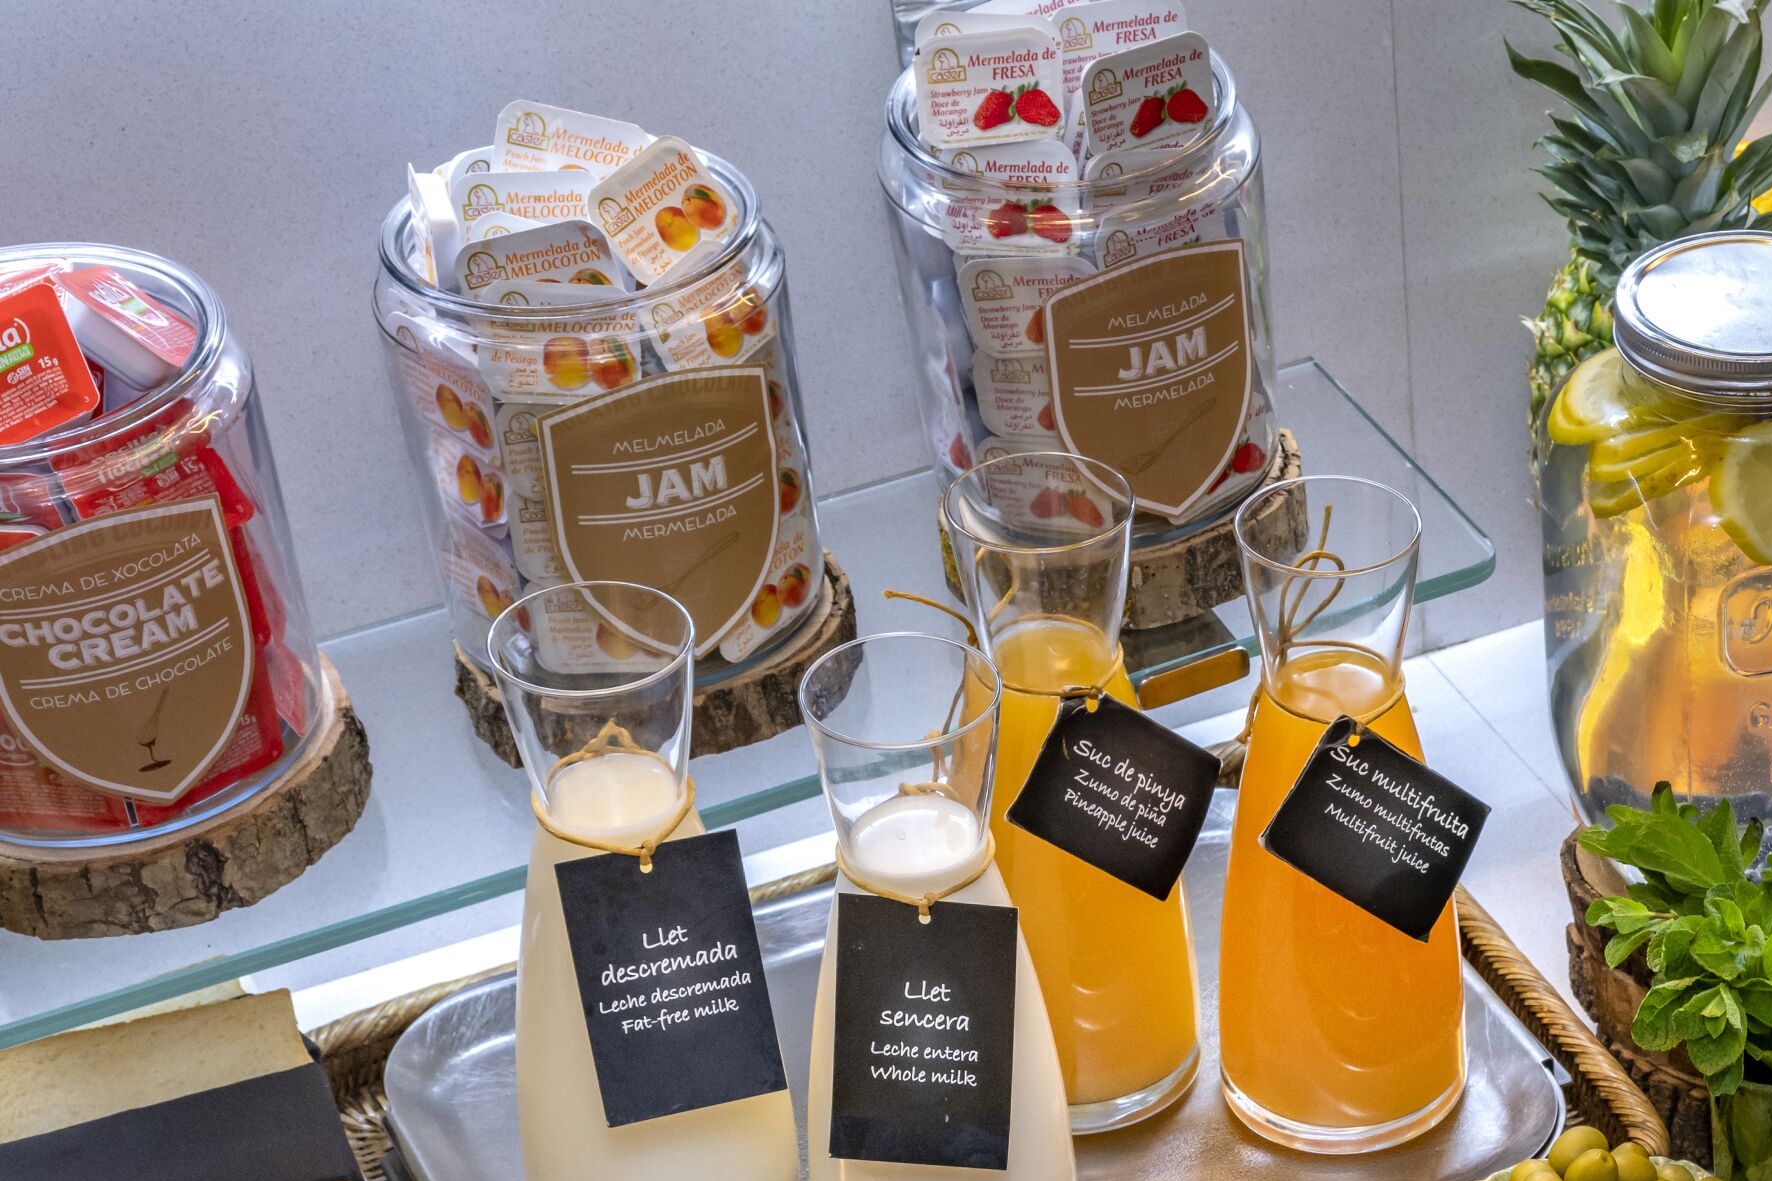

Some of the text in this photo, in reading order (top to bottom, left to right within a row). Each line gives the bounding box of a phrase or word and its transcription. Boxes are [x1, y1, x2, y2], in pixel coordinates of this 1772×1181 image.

[1093, 11, 1178, 33] Mermelada de
[1116, 27, 1157, 44] FRESA
[968, 46, 1056, 67] Mermelada de
[992, 64, 1035, 81] FRESA
[1123, 49, 1203, 81] Mermelada de
[930, 86, 988, 99] Strawberry Jam
[1144, 67, 1182, 88] FRESA
[931, 101, 950, 109] Doce
[932, 108, 968, 117] Morango
[1091, 101, 1127, 117] Strawberry
[551, 127, 630, 156] Mermelada
[624, 152, 690, 206] Mermelada de
[984, 160, 1069, 174] Mermelada de
[505, 189, 582, 204] Mermelada
[633, 163, 698, 219] MELOCOTON
[505, 237, 599, 266] Mermelada de
[510, 250, 601, 279] MELOCOTON
[978, 305, 1021, 314] Strawberry
[1107, 291, 1208, 330] MELMELADA
[37, 357, 52, 369] 15
[1117, 325, 1207, 380] JAM
[1113, 372, 1216, 411] MERMELADA
[612, 418, 726, 455] MELMELADA
[625, 454, 728, 509] JAM
[623, 504, 737, 541] MERMELADA
[0, 581, 75, 602] CREMA
[80, 571, 109, 591] DE
[112, 533, 201, 582] XOCOLATA
[0, 558, 225, 648] CHOCOLATE
[47, 603, 199, 670] CREAM
[30, 636, 233, 711] CREMA DE CHOCOLATE
[1072, 738, 1187, 811] Suc de pinya
[1072, 768, 1167, 828] Zumo de piña
[1329, 744, 1470, 840] Suc multifruita
[1063, 787, 1159, 850] Pineapple juice
[1325, 772, 1451, 859] Zumo multifrutas
[1324, 802, 1430, 875] Multifruit juice
[642, 925, 689, 949] Llet
[601, 942, 739, 986] descremada
[598, 971, 752, 1015] Leche descremada
[903, 980, 952, 1003] Llet
[620, 997, 740, 1035] Fat-free milk
[879, 1008, 970, 1032] sencera
[870, 1040, 979, 1064] Leche entera
[870, 1065, 978, 1088] Whole milk
